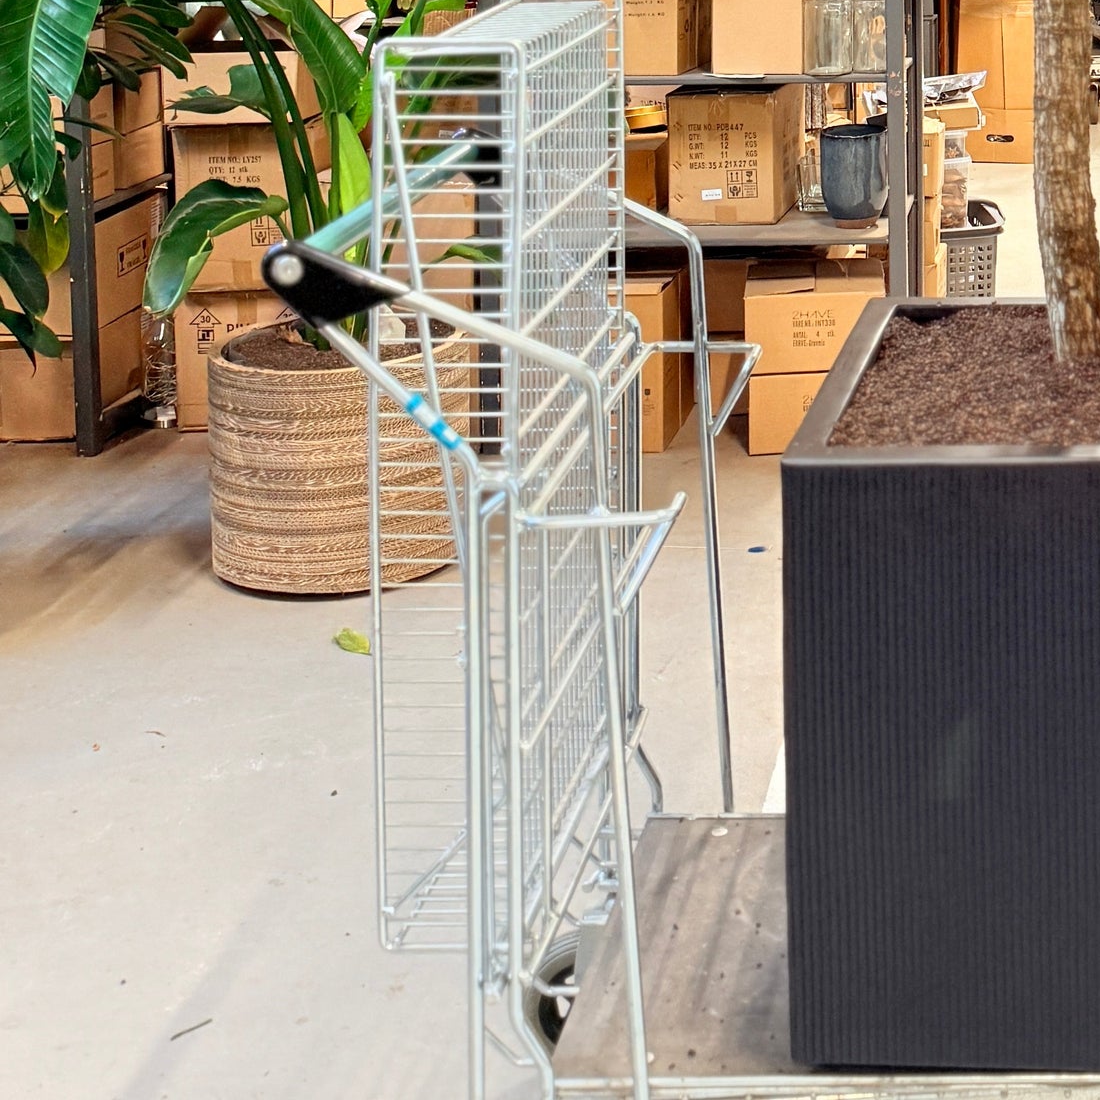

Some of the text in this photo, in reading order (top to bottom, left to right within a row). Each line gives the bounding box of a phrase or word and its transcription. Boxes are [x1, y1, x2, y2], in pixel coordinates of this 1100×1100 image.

[720, 132, 729, 141] 12
[744, 131, 757, 140] PCS
[720, 141, 729, 149] 12
[744, 140, 758, 148] KGS
[720, 150, 728, 159] 11
[745, 149, 758, 158] KGS
[208, 156, 226, 164] ITEM
[748, 159, 758, 167] CM
[229, 166, 235, 174] 12
[246, 175, 261, 183] KGS
[792, 309, 833, 320] 2HAVE
[200, 315, 211, 324] 30
